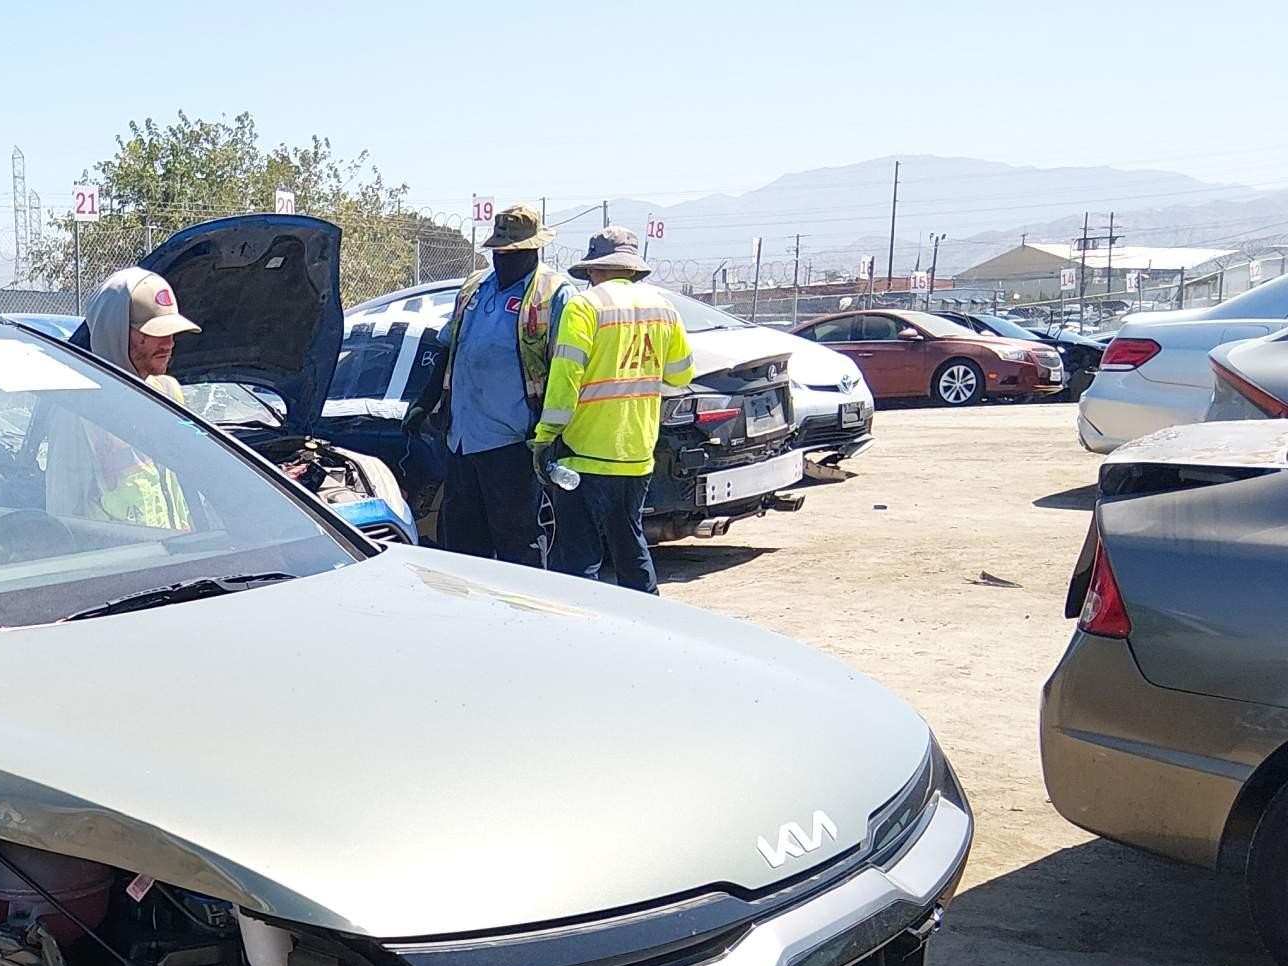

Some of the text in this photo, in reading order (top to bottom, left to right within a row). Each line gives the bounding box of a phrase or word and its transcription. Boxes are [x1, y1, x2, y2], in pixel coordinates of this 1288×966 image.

[75, 192, 98, 214] 21
[473, 202, 493, 221] 19
[648, 221, 664, 238] 18
[912, 276, 926, 290] 15
[1062, 272, 1074, 287] 14
[756, 811, 838, 868] KIA
